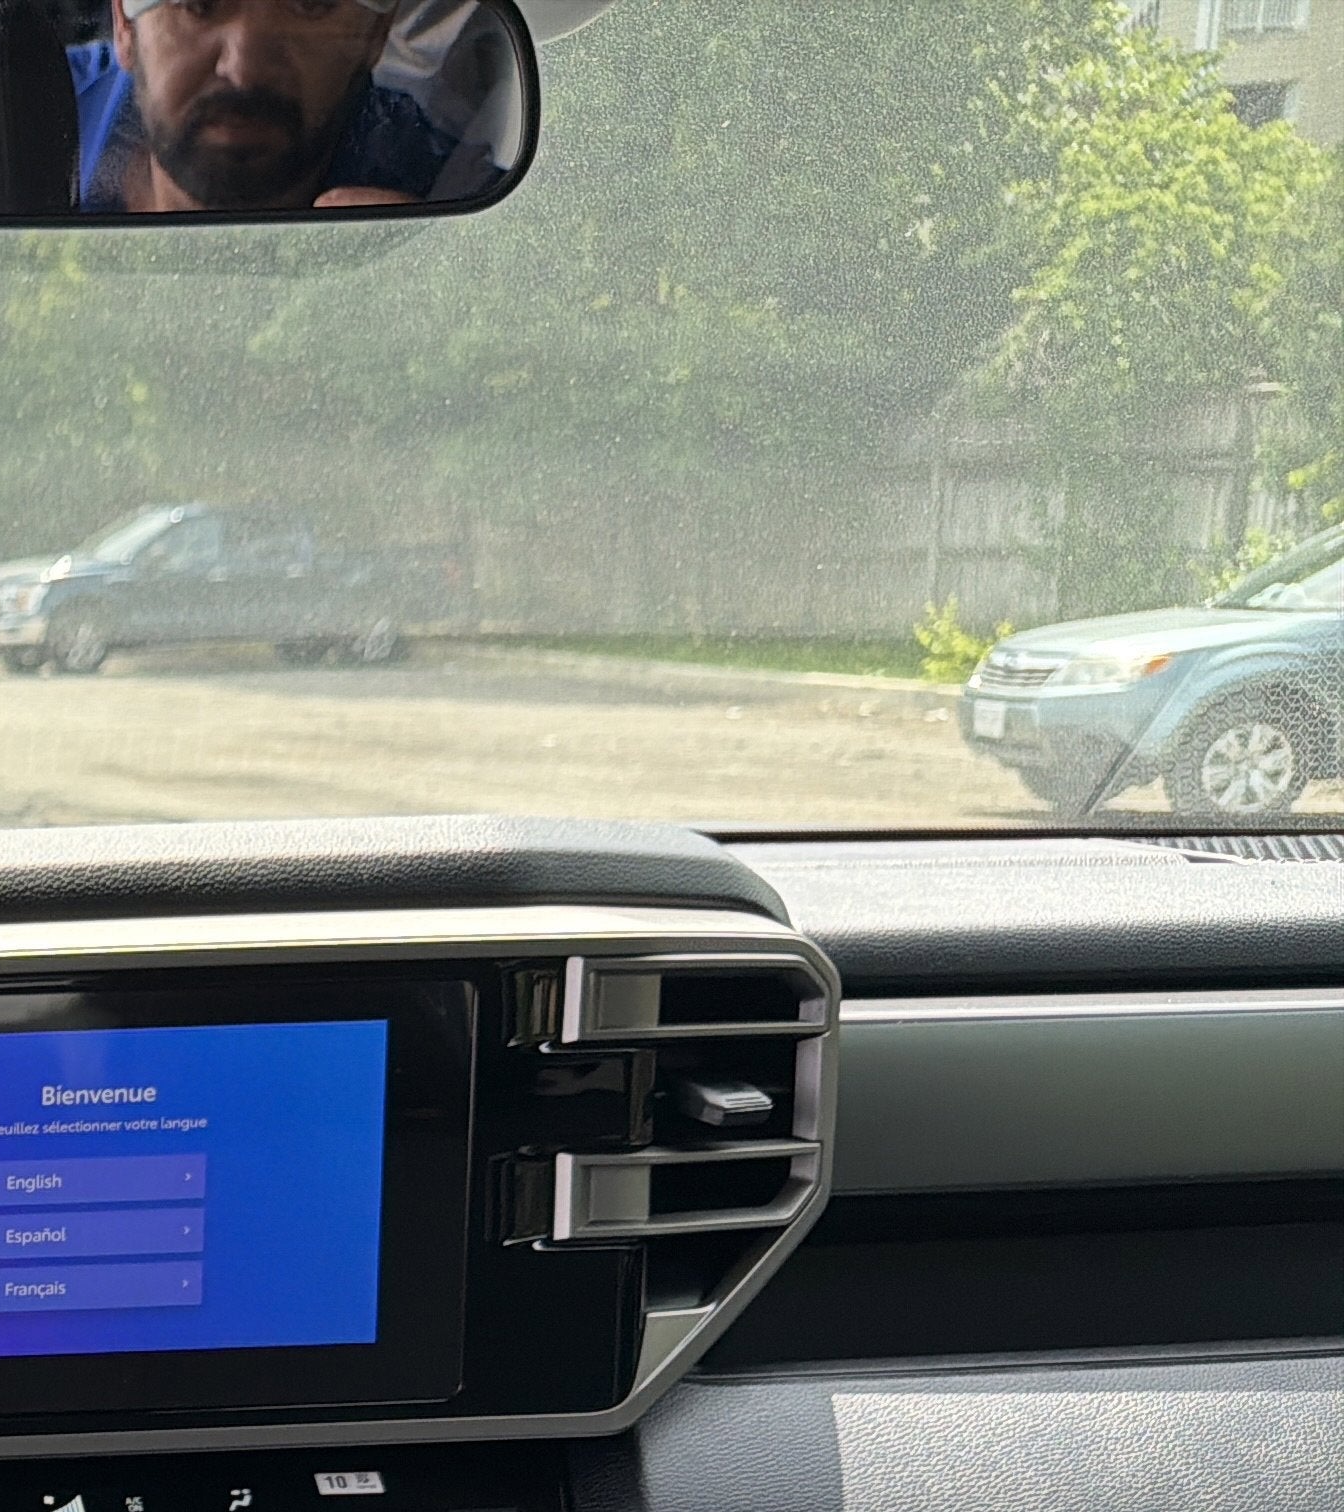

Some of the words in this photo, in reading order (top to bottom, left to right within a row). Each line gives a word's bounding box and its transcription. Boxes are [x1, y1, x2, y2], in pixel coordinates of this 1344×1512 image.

[41, 1085, 157, 1106] Bienvenue
[42, 1118, 121, 1134] sélectionner
[124, 1117, 158, 1129] votre
[161, 1116, 208, 1131] langue
[6, 1173, 63, 1193] English
[5, 1226, 66, 1246] Español
[4, 1280, 67, 1299] Français
[324, 1475, 348, 1490] 10
